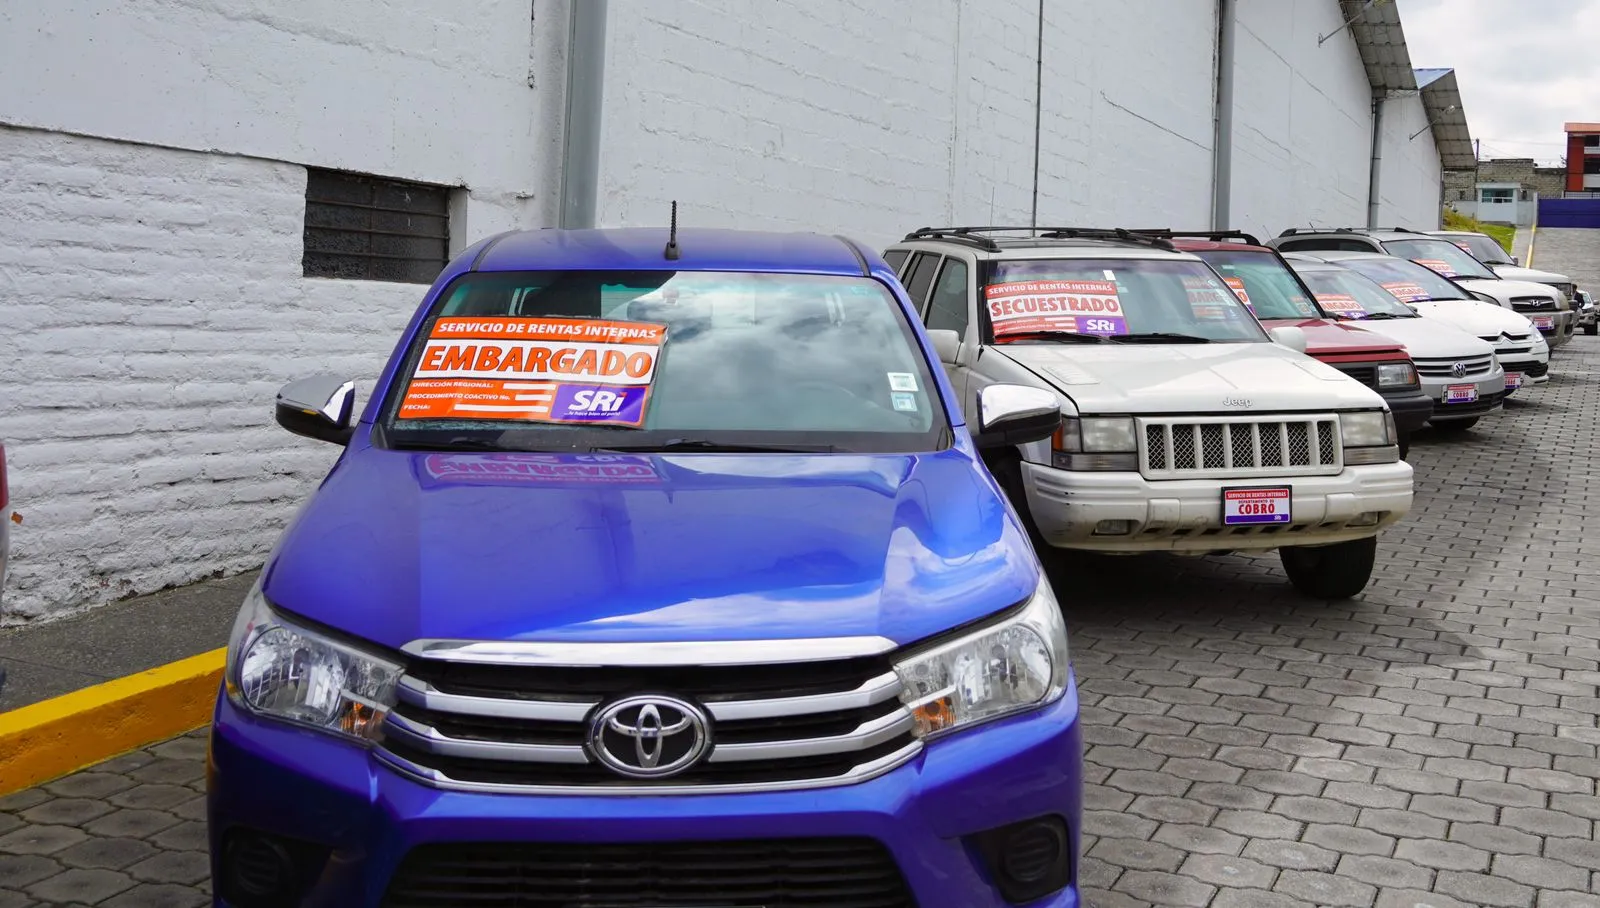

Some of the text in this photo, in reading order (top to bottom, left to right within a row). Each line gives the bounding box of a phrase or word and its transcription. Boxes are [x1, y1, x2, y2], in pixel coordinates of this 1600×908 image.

[989, 285, 1025, 294] SERVICIO
[1072, 283, 1113, 291] INTERNAS
[990, 297, 1119, 317] SECUESTRADO
[438, 323, 657, 339] SERVICIO DE RENTAS INTERNAS
[419, 345, 653, 379] EMBARGADO
[1223, 397, 1252, 408] Jeep
[1238, 503, 1275, 514] COBRO
